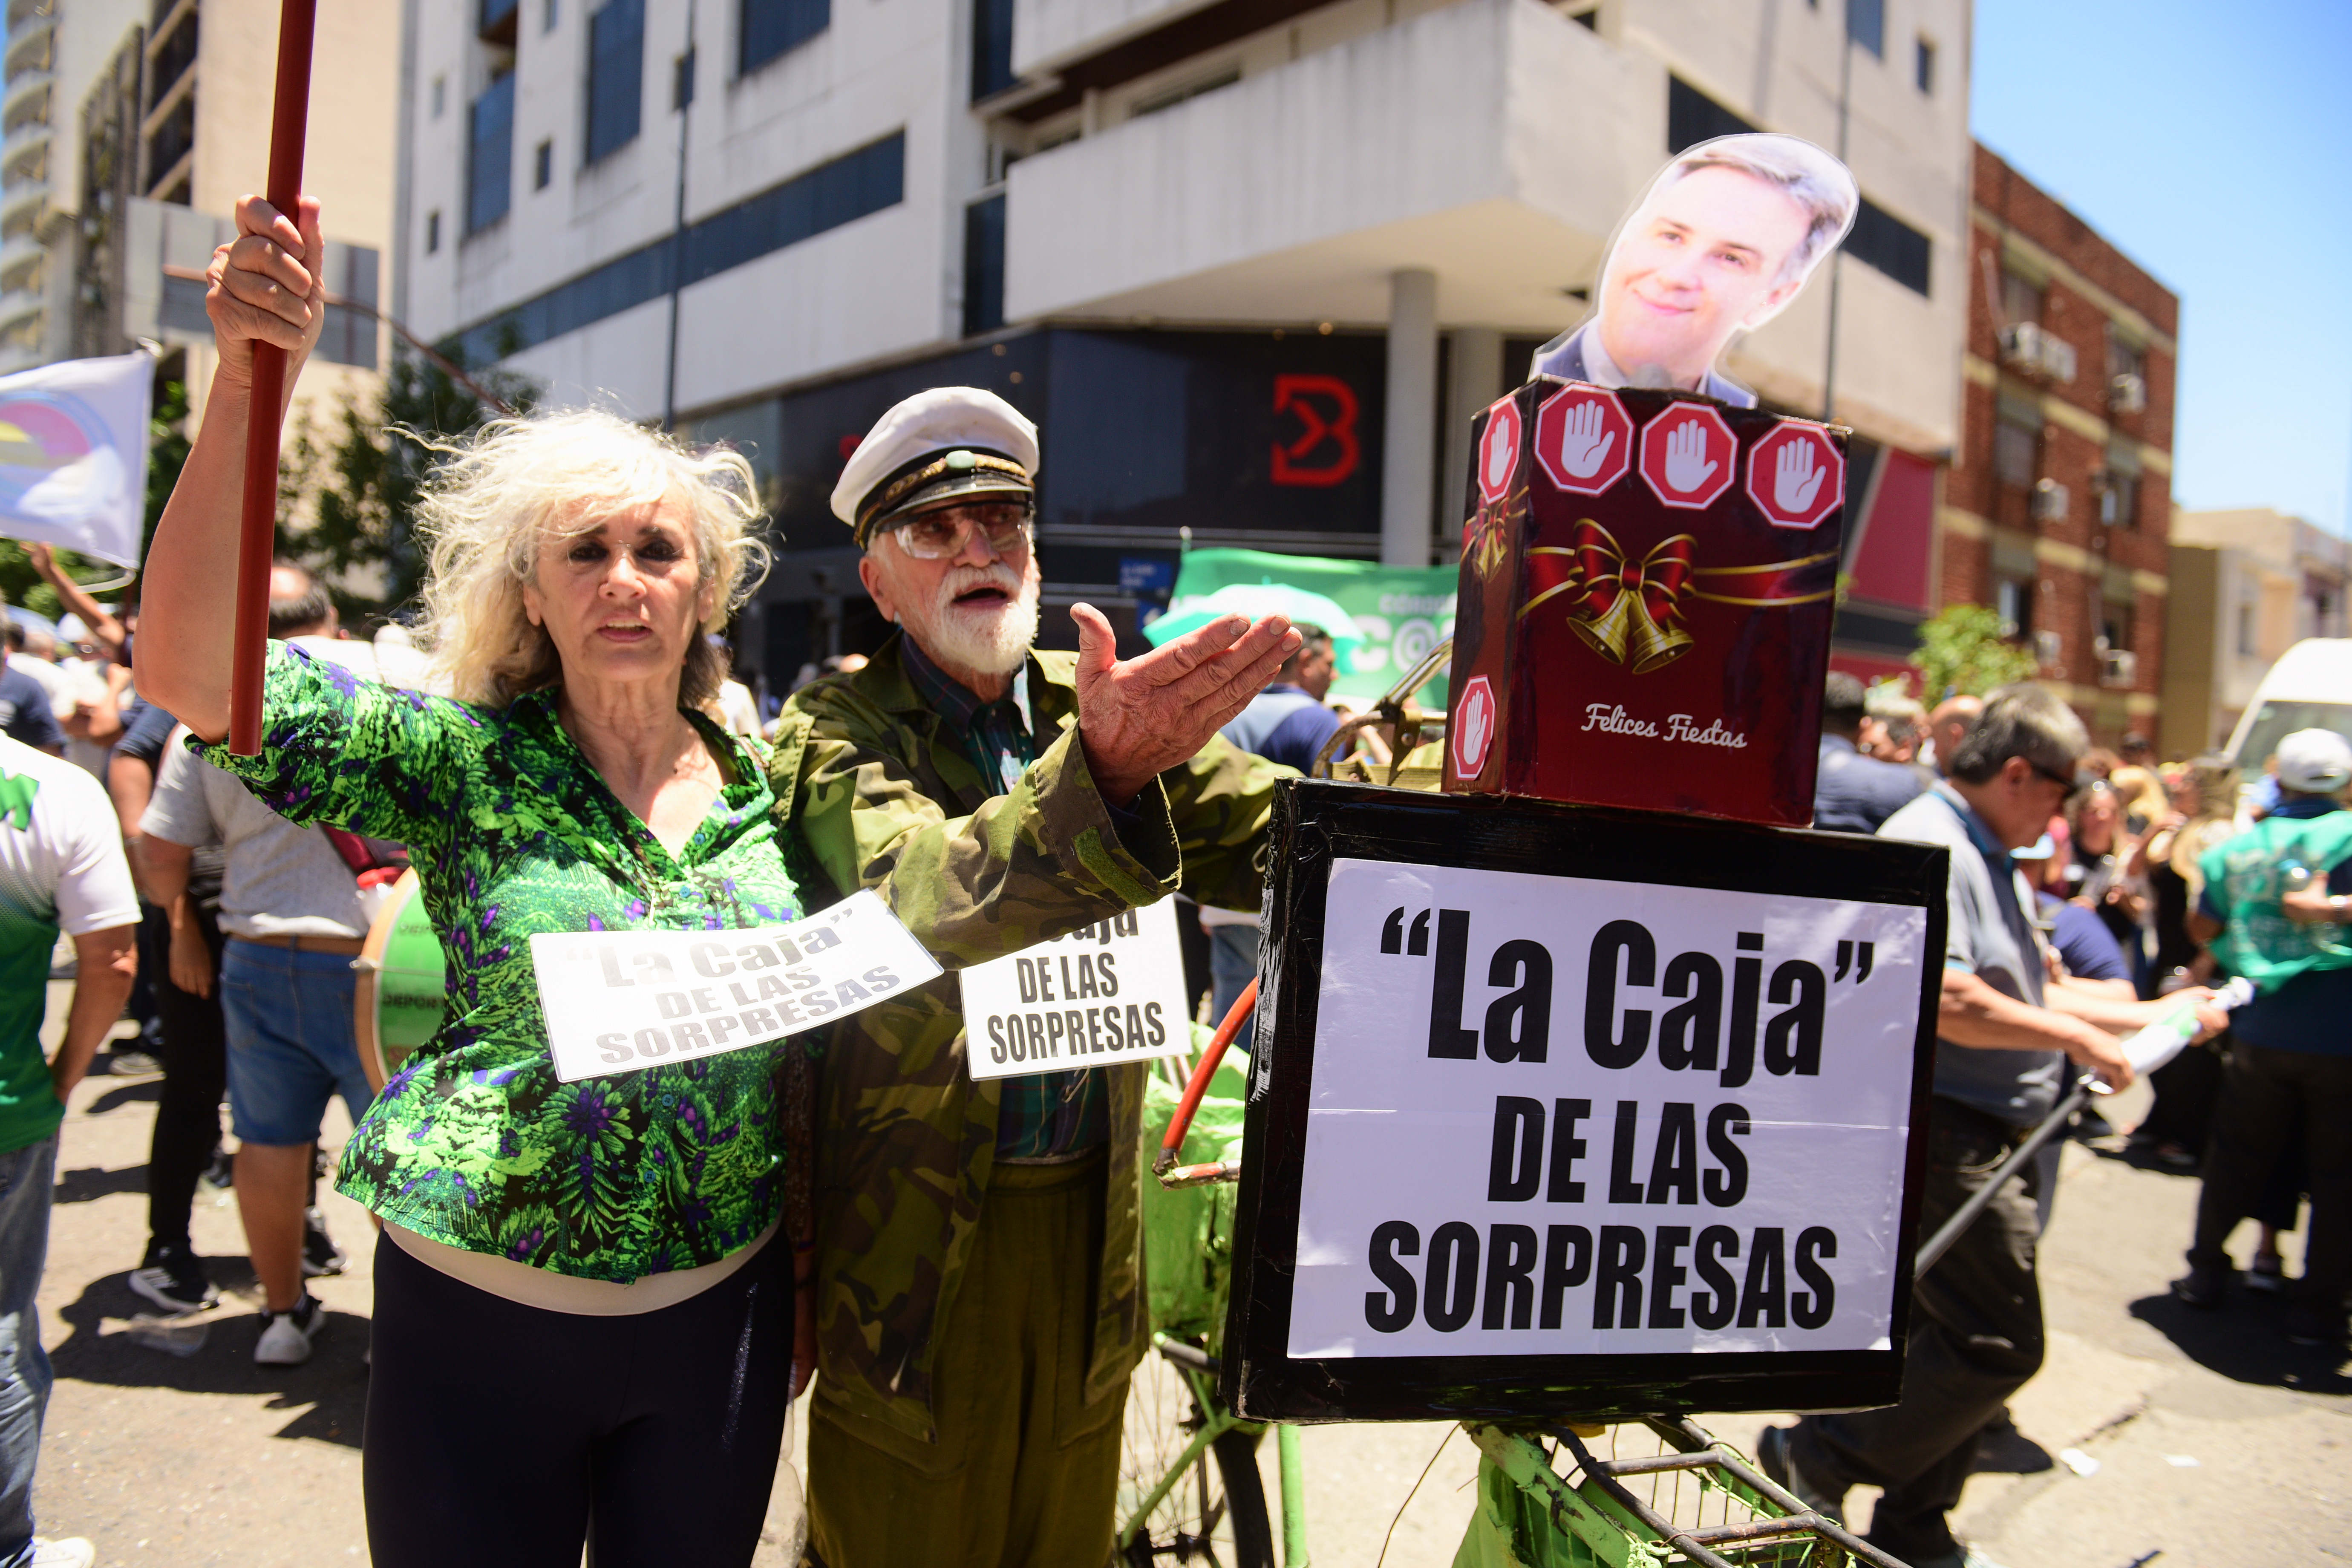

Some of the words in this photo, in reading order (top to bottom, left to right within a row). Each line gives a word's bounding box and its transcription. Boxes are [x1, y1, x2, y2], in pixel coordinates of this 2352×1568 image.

[1581, 703, 1659, 737] Felices
[1663, 714, 1747, 748] Fiestas
[596, 966, 901, 1064] SORPRESAS
[655, 987, 722, 1020] DE
[728, 966, 821, 1006] LAS
[1016, 957, 1055, 1003] DE
[1060, 952, 1118, 1000] LAS
[1380, 906, 1553, 1064] “La
[1583, 919, 1874, 1088] Caja”
[988, 1002, 1165, 1064] SORPRESAS
[1487, 1095, 1591, 1203] DE
[1608, 1100, 1752, 1208] LAS
[1364, 1220, 1837, 1333] SORPRESAS
